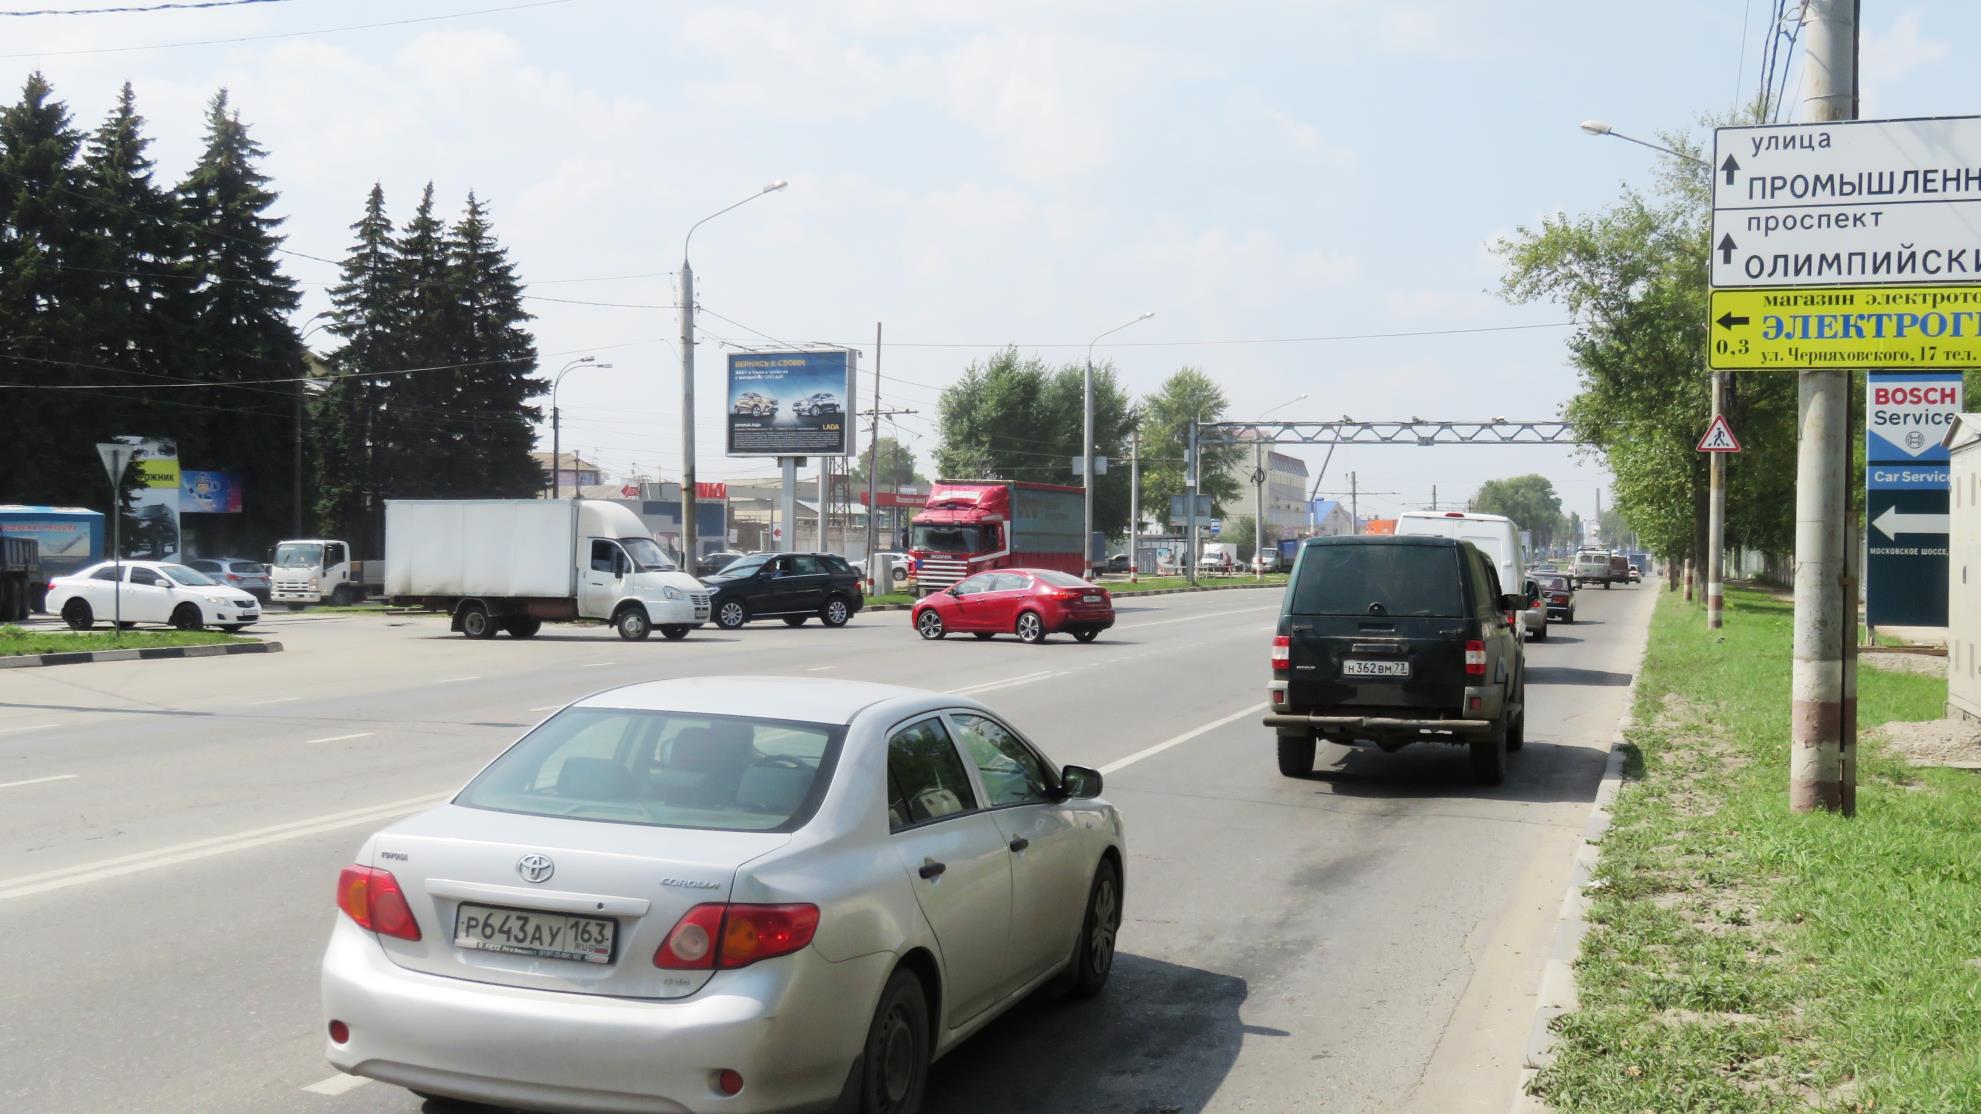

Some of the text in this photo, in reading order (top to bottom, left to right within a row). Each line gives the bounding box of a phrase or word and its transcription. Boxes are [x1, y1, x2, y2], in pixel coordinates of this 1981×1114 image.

[1751, 132, 1832, 158] улица
[1747, 211, 1884, 238] проспект
[1763, 294, 1855, 308] магазин
[1716, 338, 1750, 357] 0,3
[1760, 345, 1977, 366] ул. Черняховского, 17 тел.
[1874, 387, 1957, 405] BOSCH
[822, 423, 840, 431] LADA
[1874, 470, 1950, 482] Car Servic
[465, 912, 607, 947] Р643АУ 163
